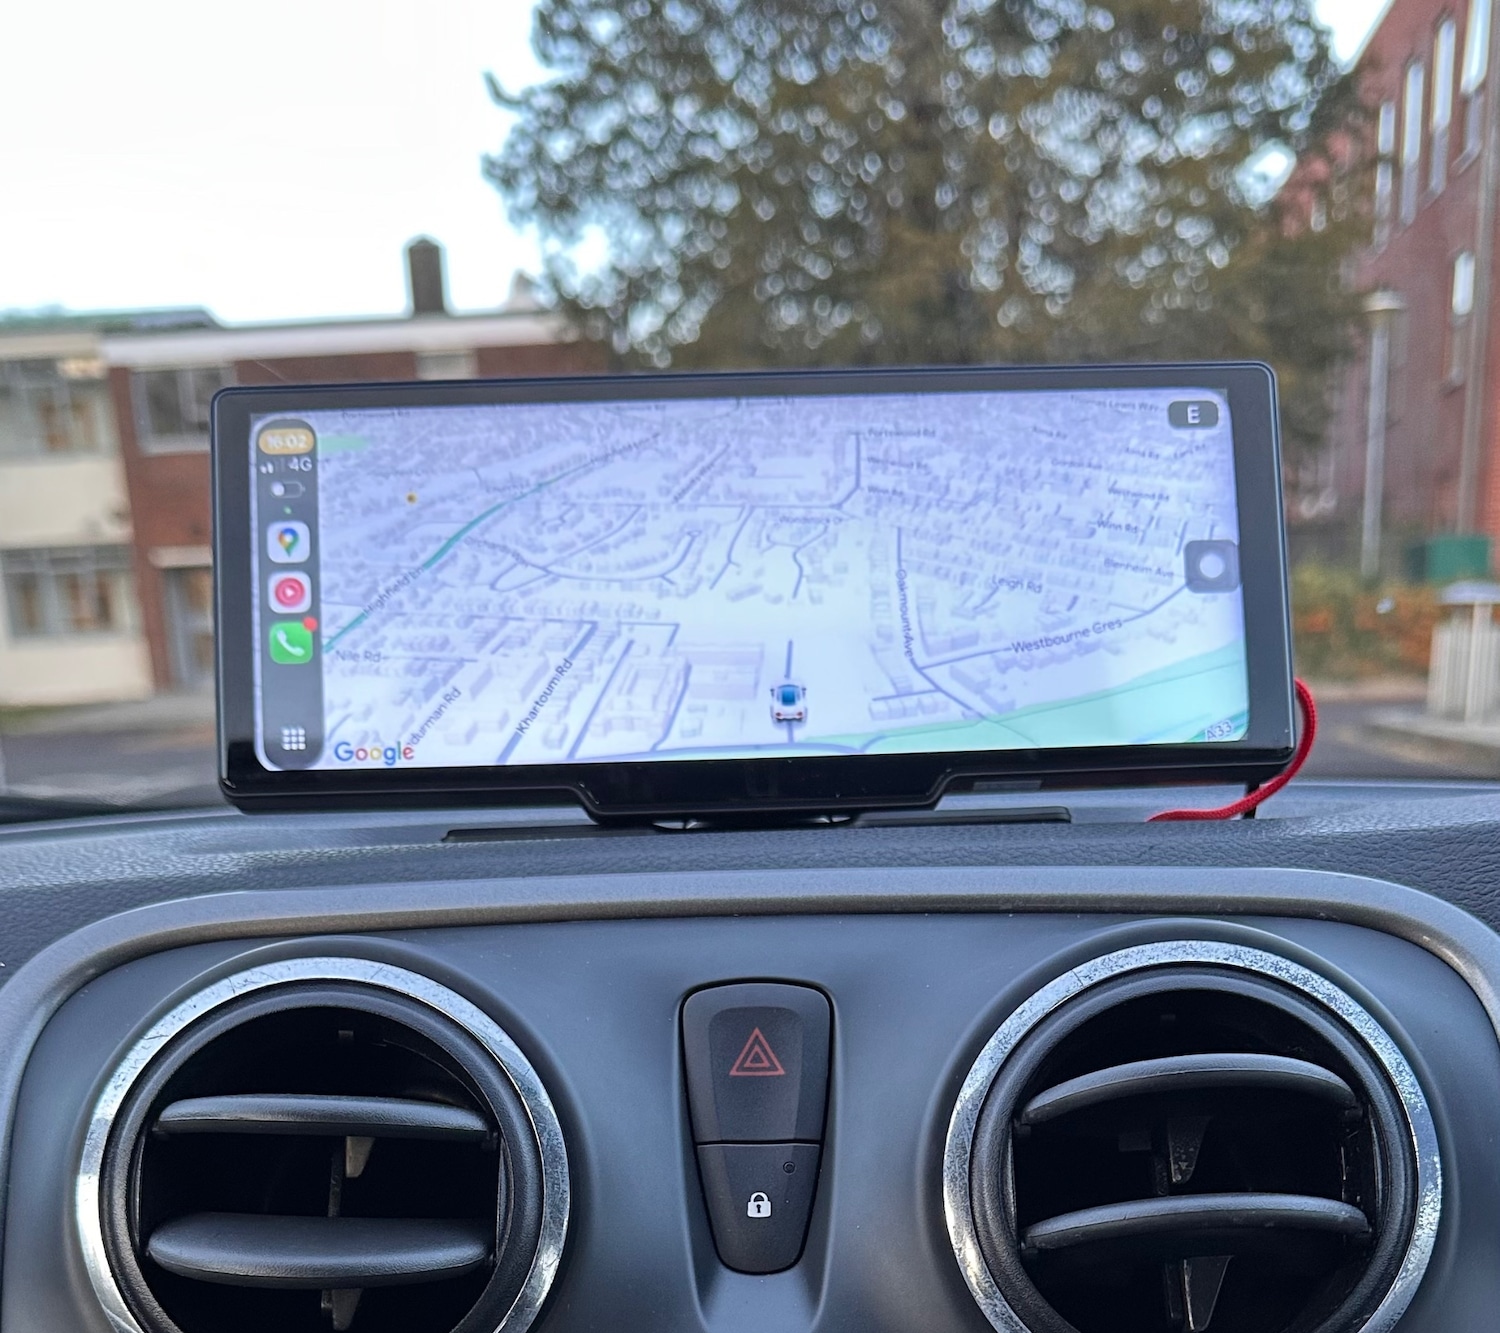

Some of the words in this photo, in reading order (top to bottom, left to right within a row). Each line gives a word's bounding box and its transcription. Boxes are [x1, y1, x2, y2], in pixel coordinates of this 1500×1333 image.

[1187, 405, 1201, 425] E
[267, 433, 308, 450] 16:02
[288, 456, 313, 472] 4G
[1096, 518, 1123, 532] Winn
[1124, 521, 1140, 534] Rd
[1154, 565, 1175, 579] Ave
[991, 574, 1024, 592] Leigh
[1026, 580, 1044, 595] Rd
[1010, 624, 1091, 654] Westbourne
[335, 650, 361, 662] Nile
[363, 651, 382, 664] Rd
[443, 686, 463, 711] Rd
[516, 675, 561, 735] Khartoum
[555, 656, 574, 679] Rd
[1206, 720, 1232, 741] A33
[335, 741, 415, 766] Google
